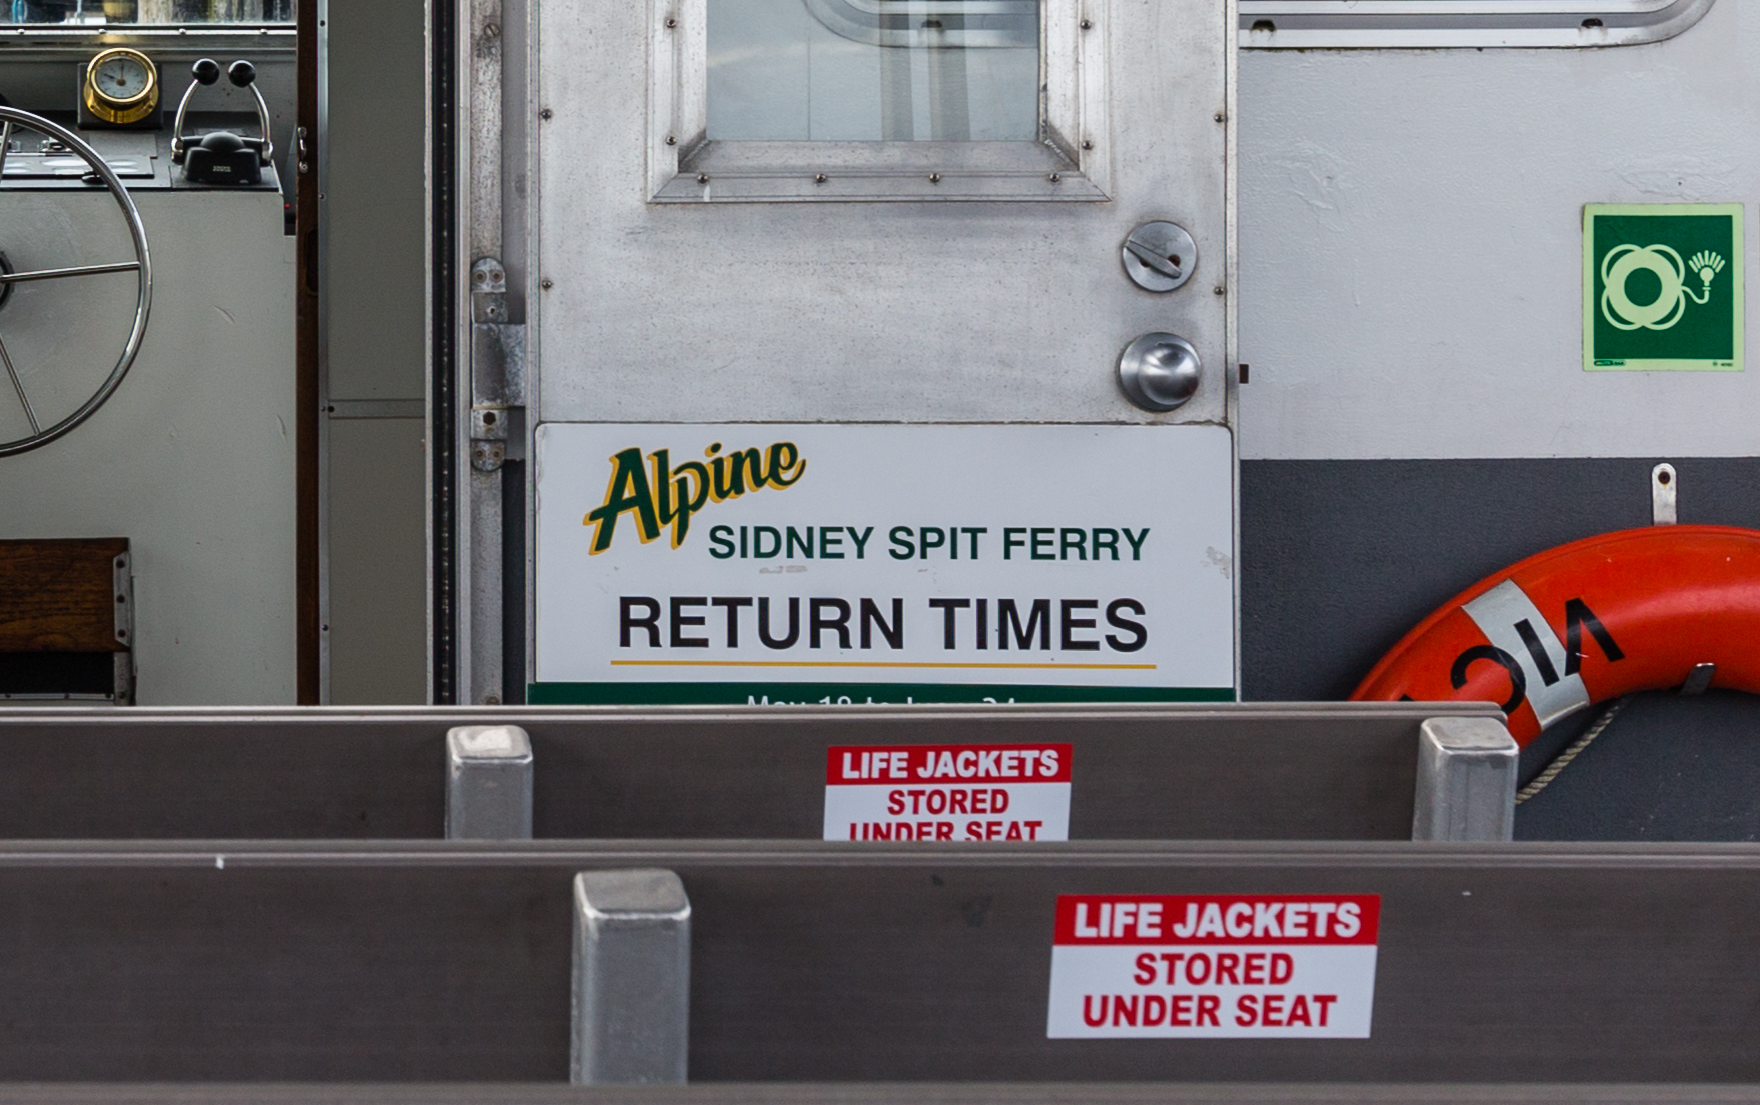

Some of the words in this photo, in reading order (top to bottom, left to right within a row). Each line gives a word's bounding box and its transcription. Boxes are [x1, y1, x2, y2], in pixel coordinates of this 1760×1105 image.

[583, 441, 806, 556] Alpine
[708, 525, 875, 560] SIDNEY
[888, 525, 987, 561] SPIT
[1003, 527, 1151, 561] FERRY
[619, 596, 904, 651] RETURN
[929, 597, 1148, 653] TIMES
[842, 751, 909, 779] LIFE
[917, 749, 1059, 778] JACKETS
[887, 788, 1009, 815] STORED
[849, 821, 955, 841] UNDER
[964, 820, 1042, 841] SEAT
[1074, 903, 1163, 938] LIFE
[1172, 902, 1361, 938] JACKETS
[1133, 952, 1294, 986] STORED
[1083, 995, 1221, 1028] UNDER
[1235, 994, 1337, 1028] SEAT
